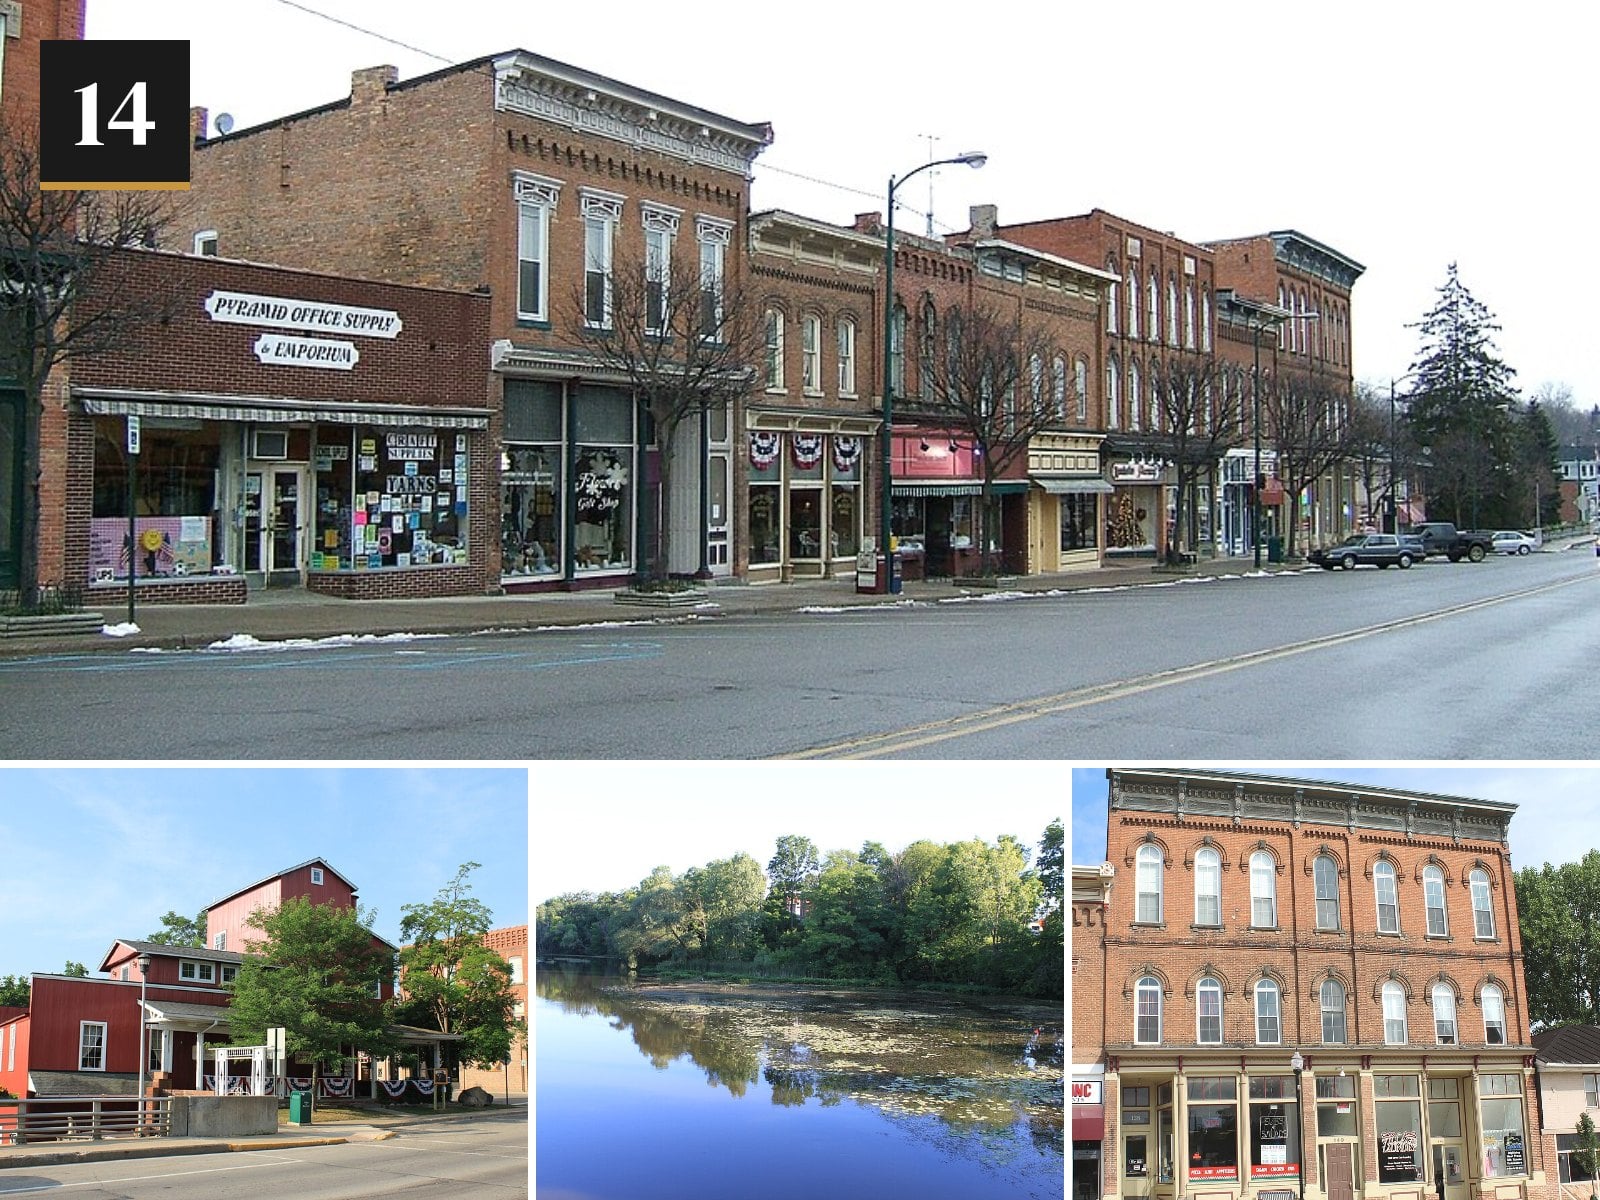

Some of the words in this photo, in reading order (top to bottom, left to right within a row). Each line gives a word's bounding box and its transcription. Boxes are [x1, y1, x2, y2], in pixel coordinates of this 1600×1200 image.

[214, 297, 288, 321] PYRAMID
[291, 307, 341, 327] OFFICE
[343, 312, 395, 332] SUPPLY
[261, 344, 270, 354] &
[275, 341, 351, 363] EMPORIUM
[386, 432, 437, 447] CRAFT
[388, 447, 434, 460] SUPPLIES
[386, 475, 436, 493] YARNS
